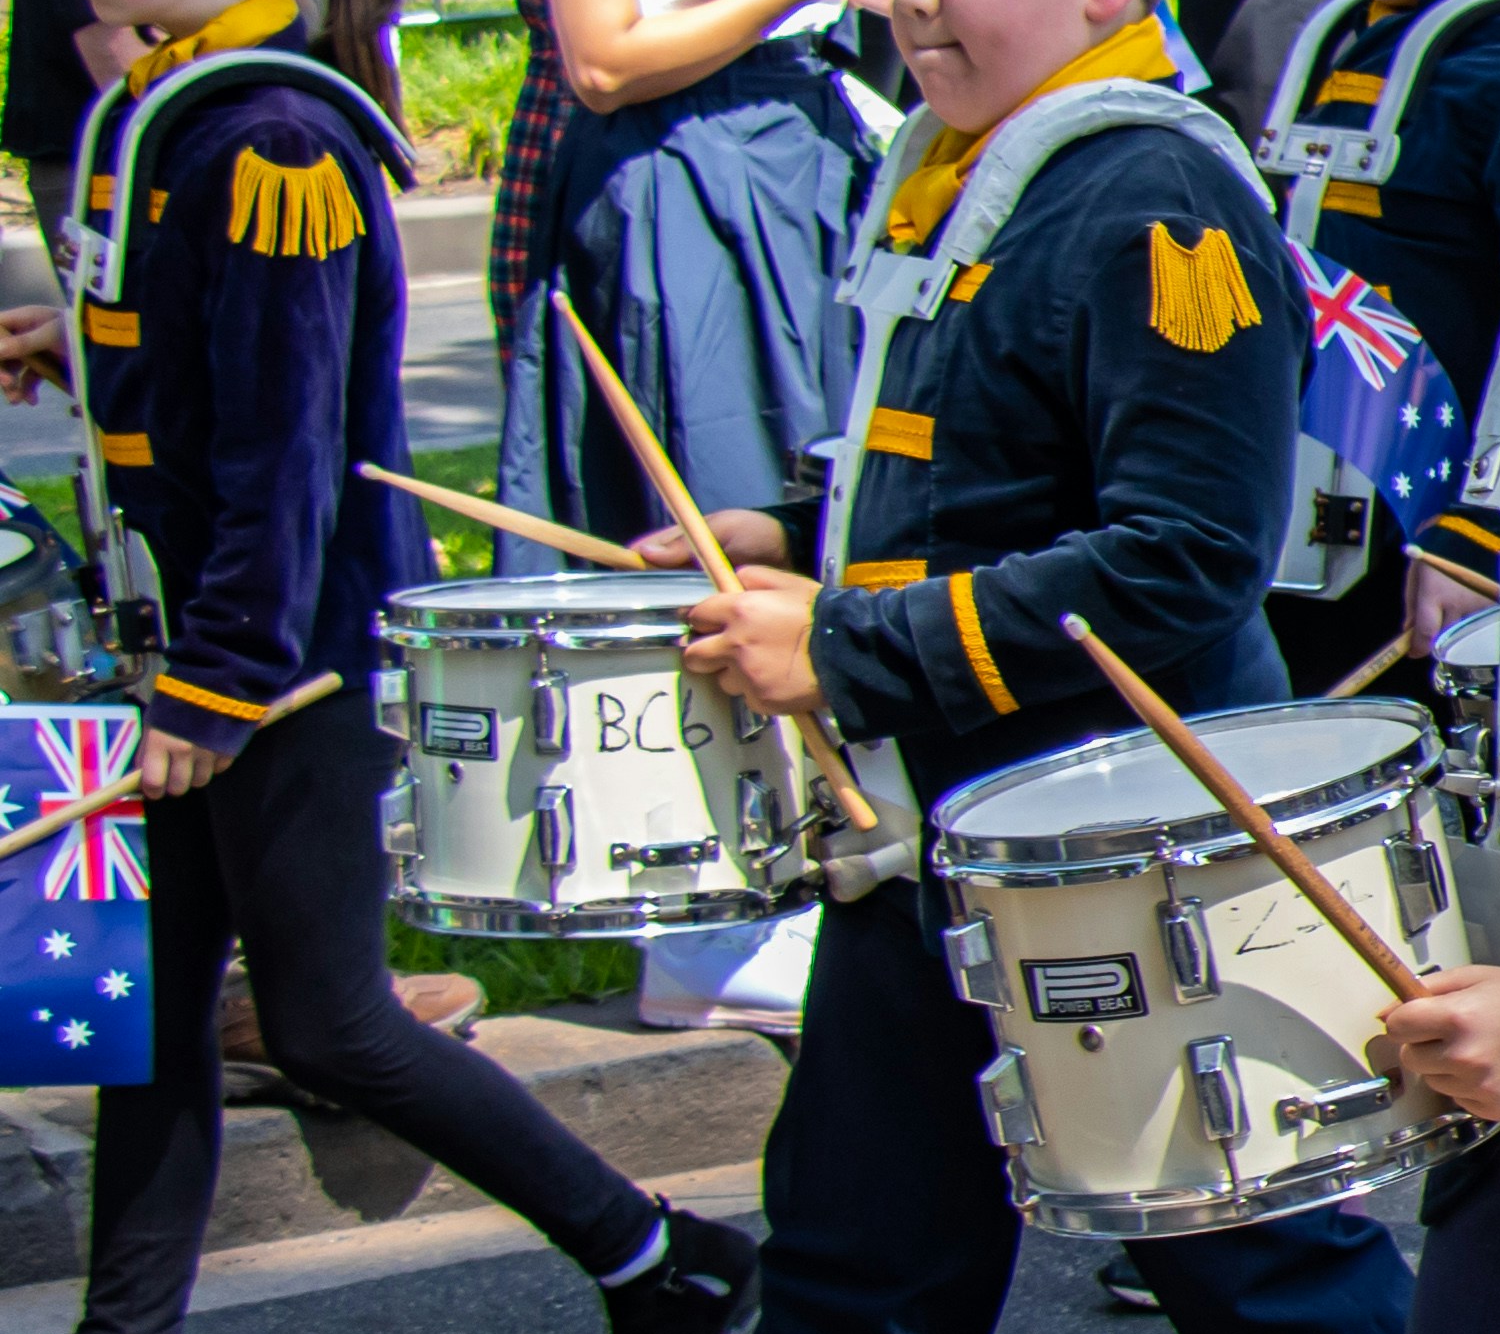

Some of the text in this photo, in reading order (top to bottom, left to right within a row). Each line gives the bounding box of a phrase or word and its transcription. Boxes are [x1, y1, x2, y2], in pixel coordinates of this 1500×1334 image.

[596, 688, 714, 753] BC6
[463, 740, 489, 752] BEAT
[1049, 996, 1134, 1014] POWER BEAT
